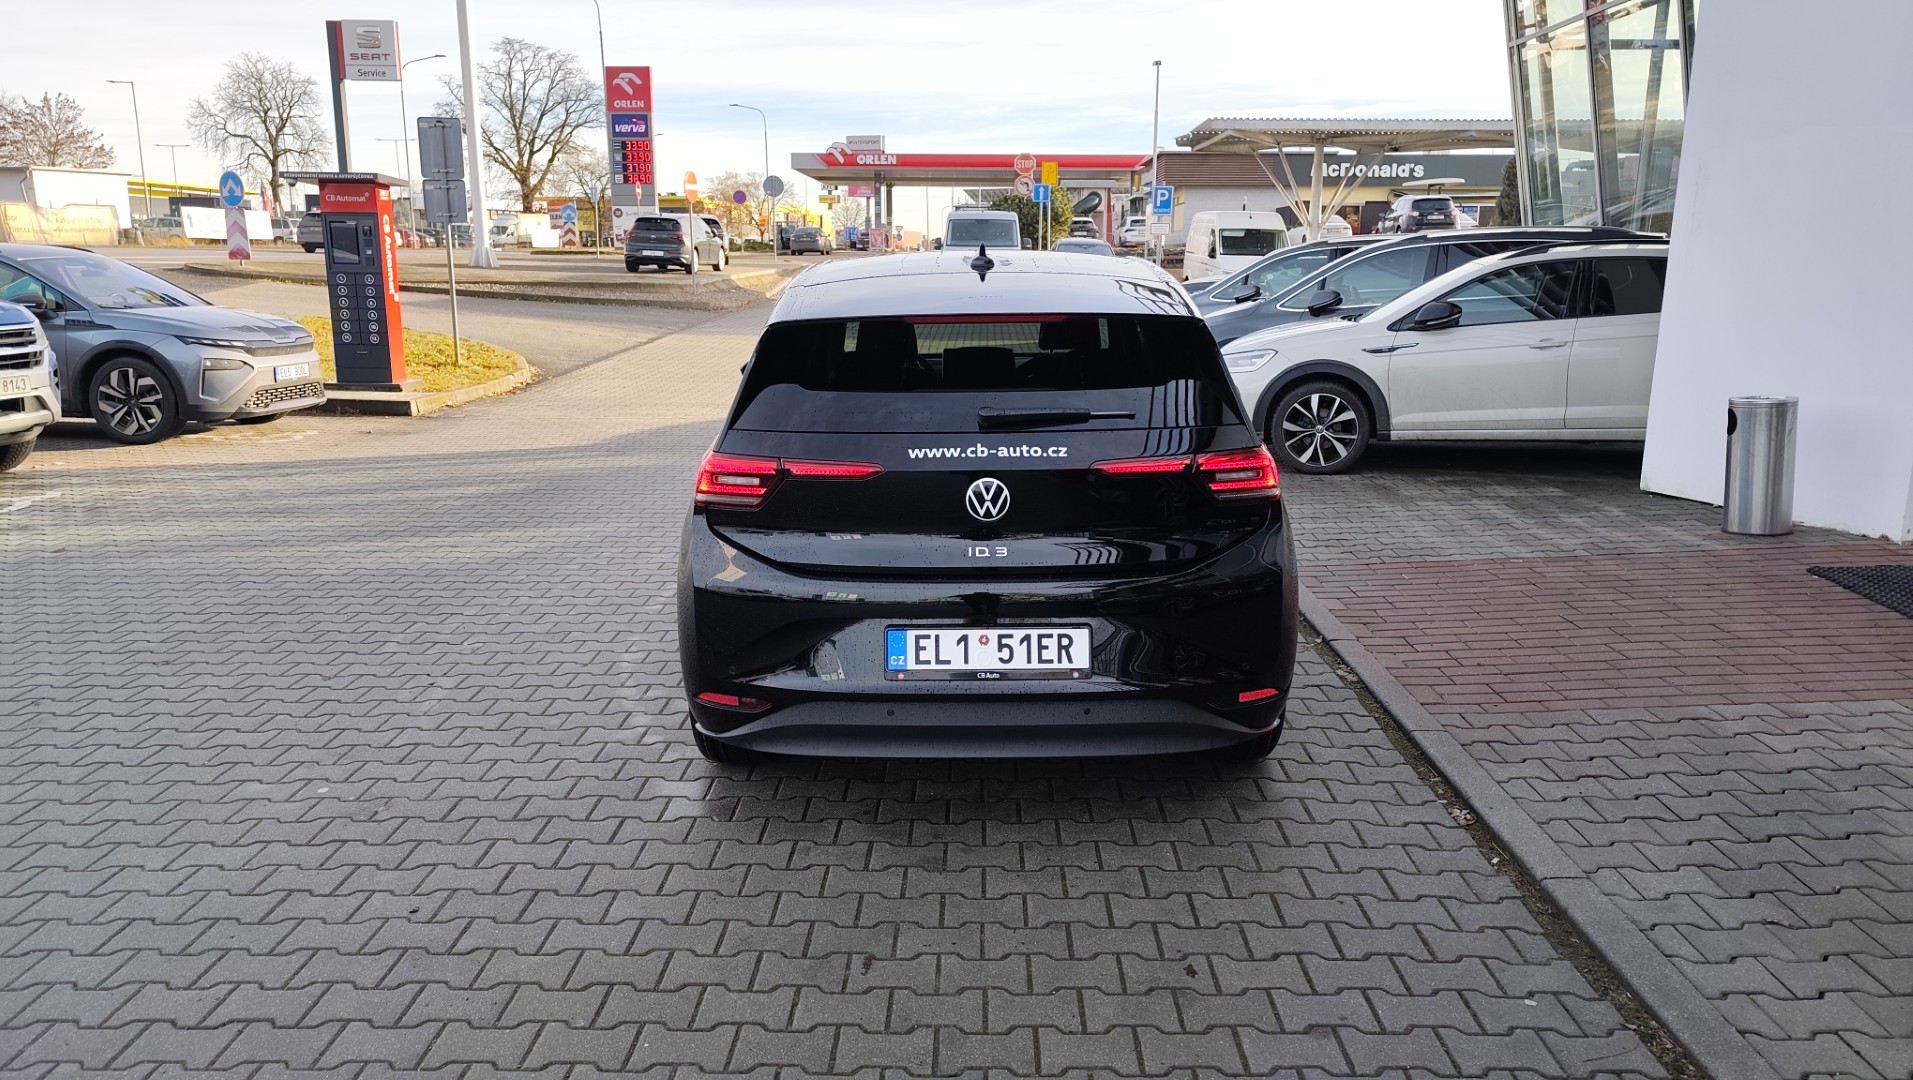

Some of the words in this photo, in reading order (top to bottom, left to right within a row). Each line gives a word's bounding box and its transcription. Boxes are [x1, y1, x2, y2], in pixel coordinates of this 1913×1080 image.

[349, 53, 390, 61] SEAT
[357, 68, 387, 78] Service
[613, 100, 645, 108] ORLEN
[614, 124, 646, 133] verva
[856, 154, 897, 165] ORLEN
[1016, 159, 1034, 169] STOP
[325, 194, 336, 202] CB
[1156, 189, 1169, 207] P
[382, 214, 391, 234] CB
[2, 378, 27, 393] 8143
[908, 443, 1068, 459] www.cb-auto.cz
[914, 633, 969, 665] EL1
[997, 633, 1074, 665] 51ER
[890, 655, 905, 666] CZ
